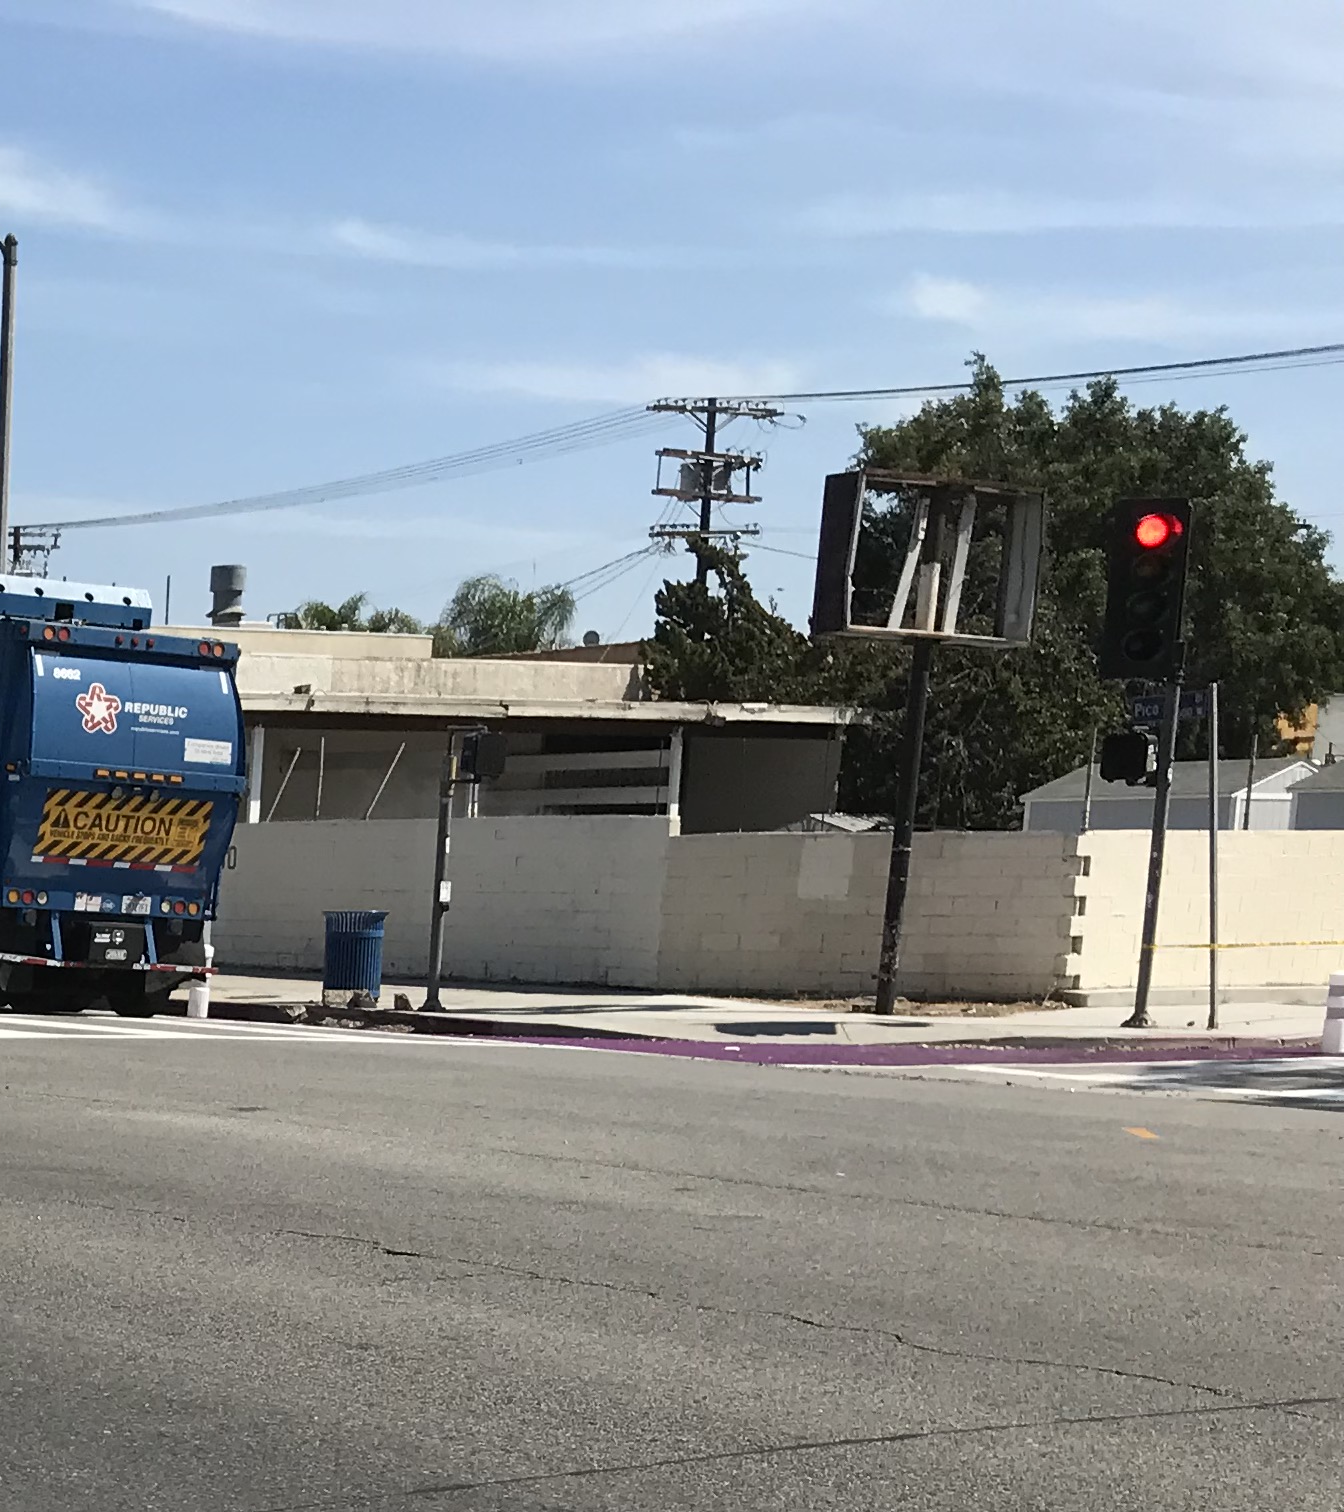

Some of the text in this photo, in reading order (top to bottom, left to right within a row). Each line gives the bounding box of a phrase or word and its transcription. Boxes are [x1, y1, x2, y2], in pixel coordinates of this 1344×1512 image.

[124, 701, 188, 719] REPUBLIC
[1134, 703, 1159, 718] Pico
[138, 714, 174, 726] SERVICES
[73, 811, 173, 836] CAUTION
[50, 829, 170, 846] VEHICLE STOPS AND BACKS FREQUENTLY
